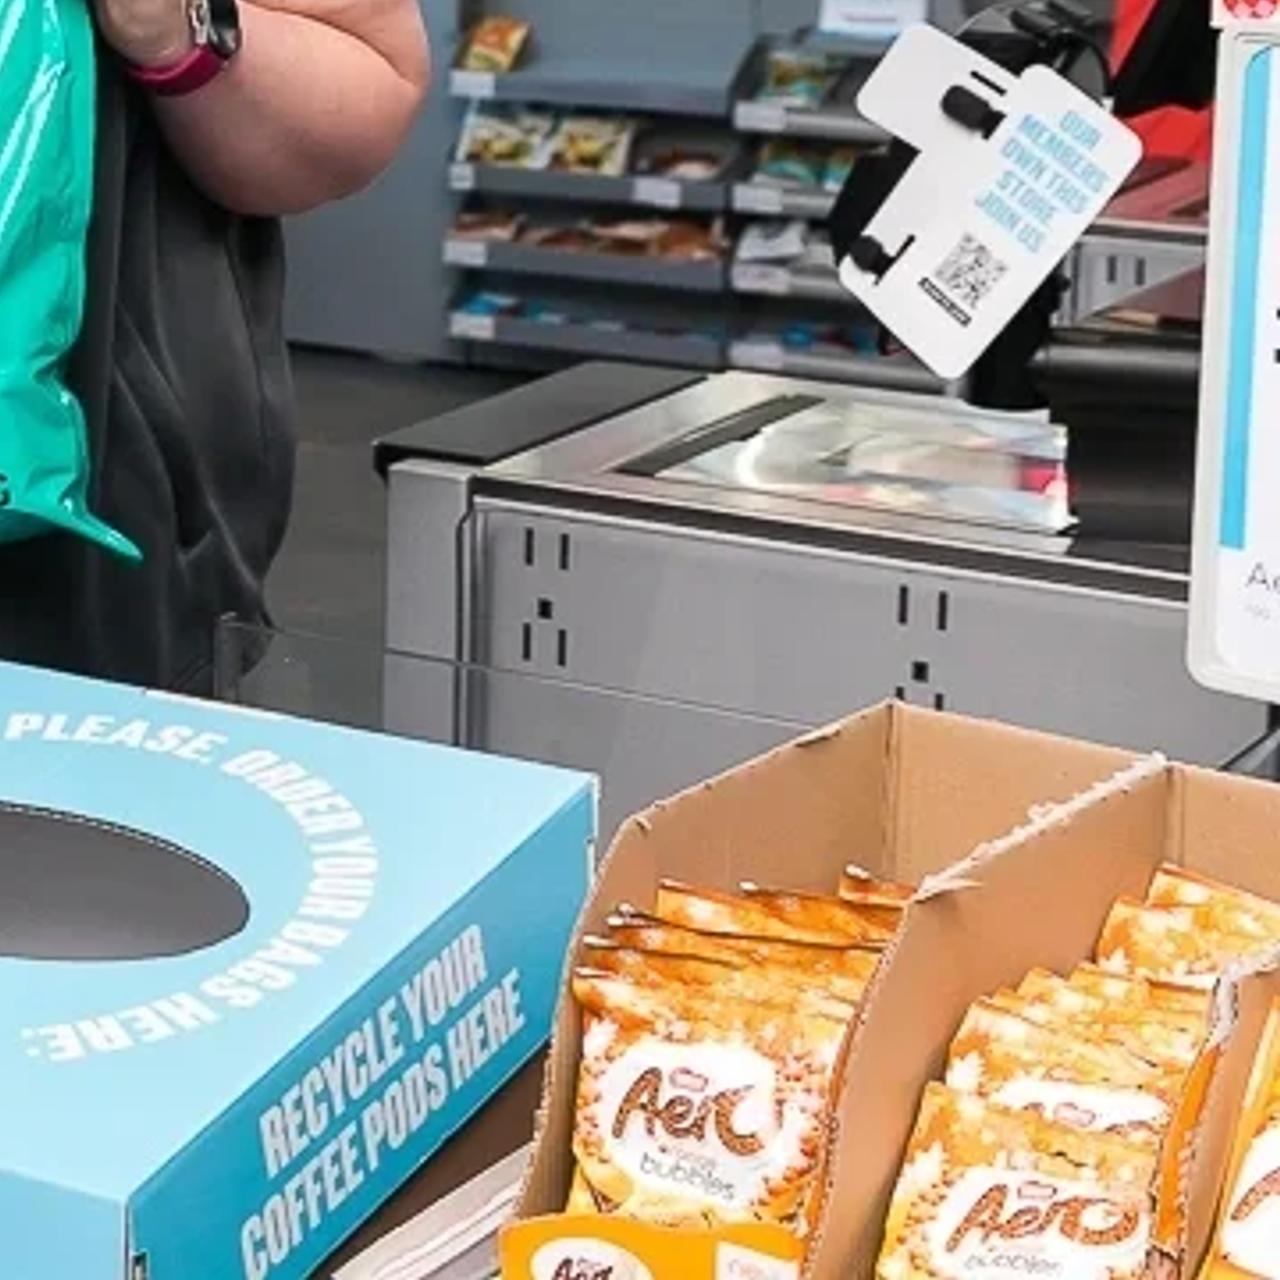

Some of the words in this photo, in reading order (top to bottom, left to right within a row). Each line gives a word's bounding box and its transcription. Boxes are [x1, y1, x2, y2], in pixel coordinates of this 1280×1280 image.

[1002, 138, 1047, 181] OWN
[1018, 114, 1110, 193] MEMBERS
[996, 170, 1056, 224] STORE
[4, 713, 229, 763] PLEASE.
[221, 749, 364, 836] ORDER
[298, 835, 379, 919] YOUR
[200, 922, 350, 1007] BAGS
[260, 995, 405, 1179] RECYCLE
[401, 924, 487, 1042] YOUR
[241, 1121, 364, 1280] COFFEE
[361, 1044, 449, 1171] PODS
[447, 968, 525, 1090] HERE
[640, 1152, 734, 1200] bubbles
